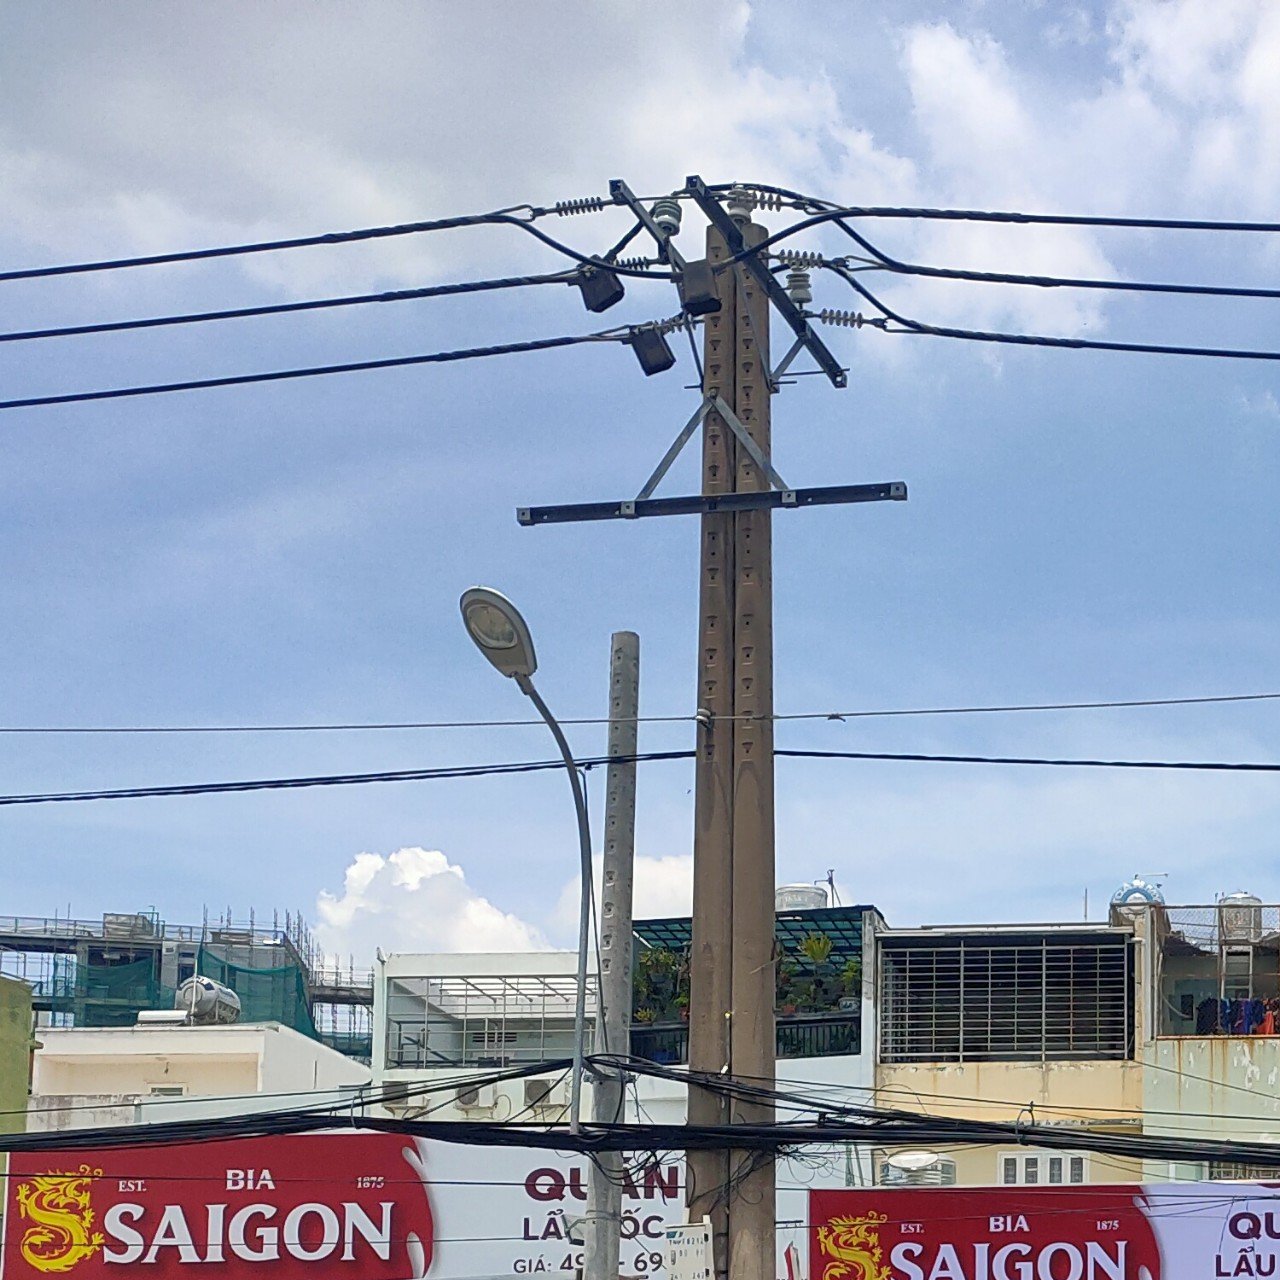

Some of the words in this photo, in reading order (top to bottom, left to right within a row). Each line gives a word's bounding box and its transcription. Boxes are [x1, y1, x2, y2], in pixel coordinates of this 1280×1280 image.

[118, 1180, 147, 1192] EST.
[226, 1169, 276, 1191] BIA
[103, 1201, 395, 1265] SAIGON
[900, 1223, 925, 1234] EST.
[989, 1214, 1030, 1233] BIA
[1096, 1220, 1119, 1231] 1875
[513, 1254, 552, 1274] GIÁ:
[633, 1251, 664, 1272] 69
[1215, 1245, 1276, 1278] LẨU
